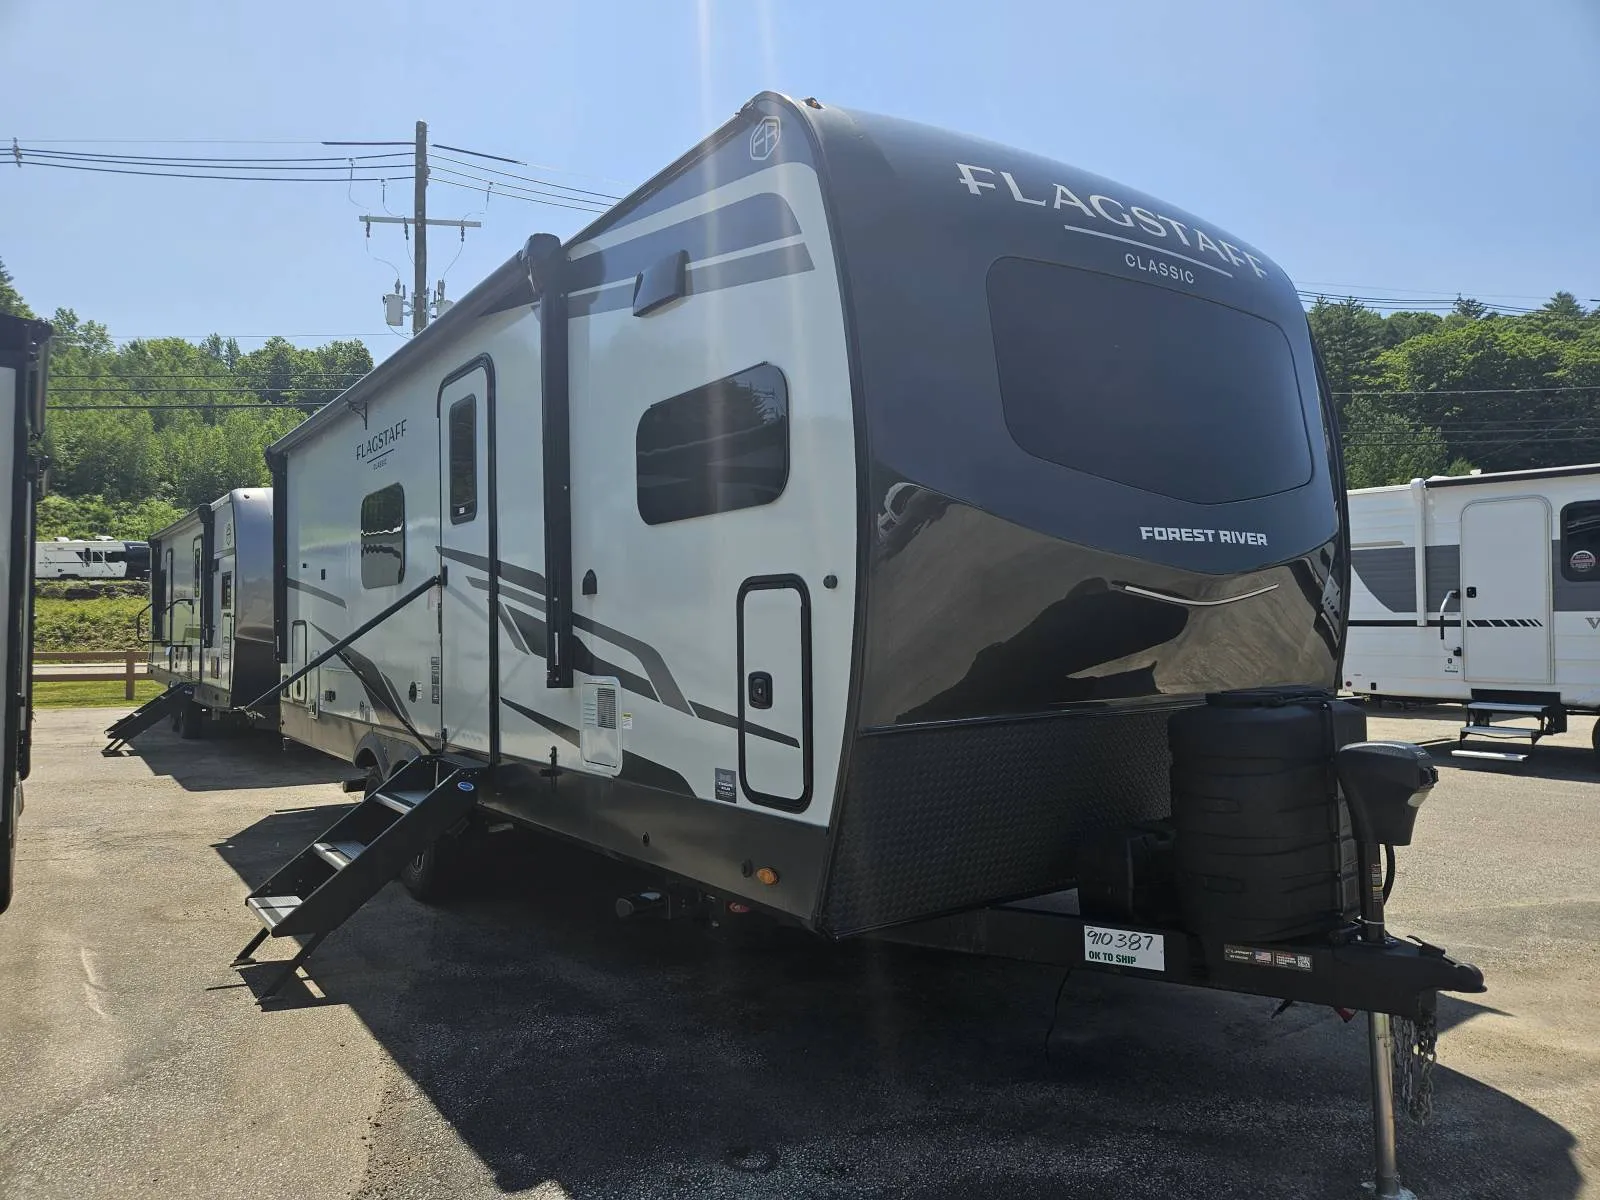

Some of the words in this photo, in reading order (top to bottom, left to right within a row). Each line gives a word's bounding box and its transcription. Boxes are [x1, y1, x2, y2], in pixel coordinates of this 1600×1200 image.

[956, 162, 1268, 278] FLAGSTAFF
[1125, 253, 1195, 284] CLASSIC
[356, 419, 407, 460] FLAGSTAFF
[1139, 526, 1215, 542] FOREST
[1218, 530, 1268, 545] RIVER
[1086, 930, 1154, 951] 910387
[1088, 950, 1101, 960] OK
[1102, 952, 1114, 962] TO
[1116, 954, 1137, 965] SHIP
